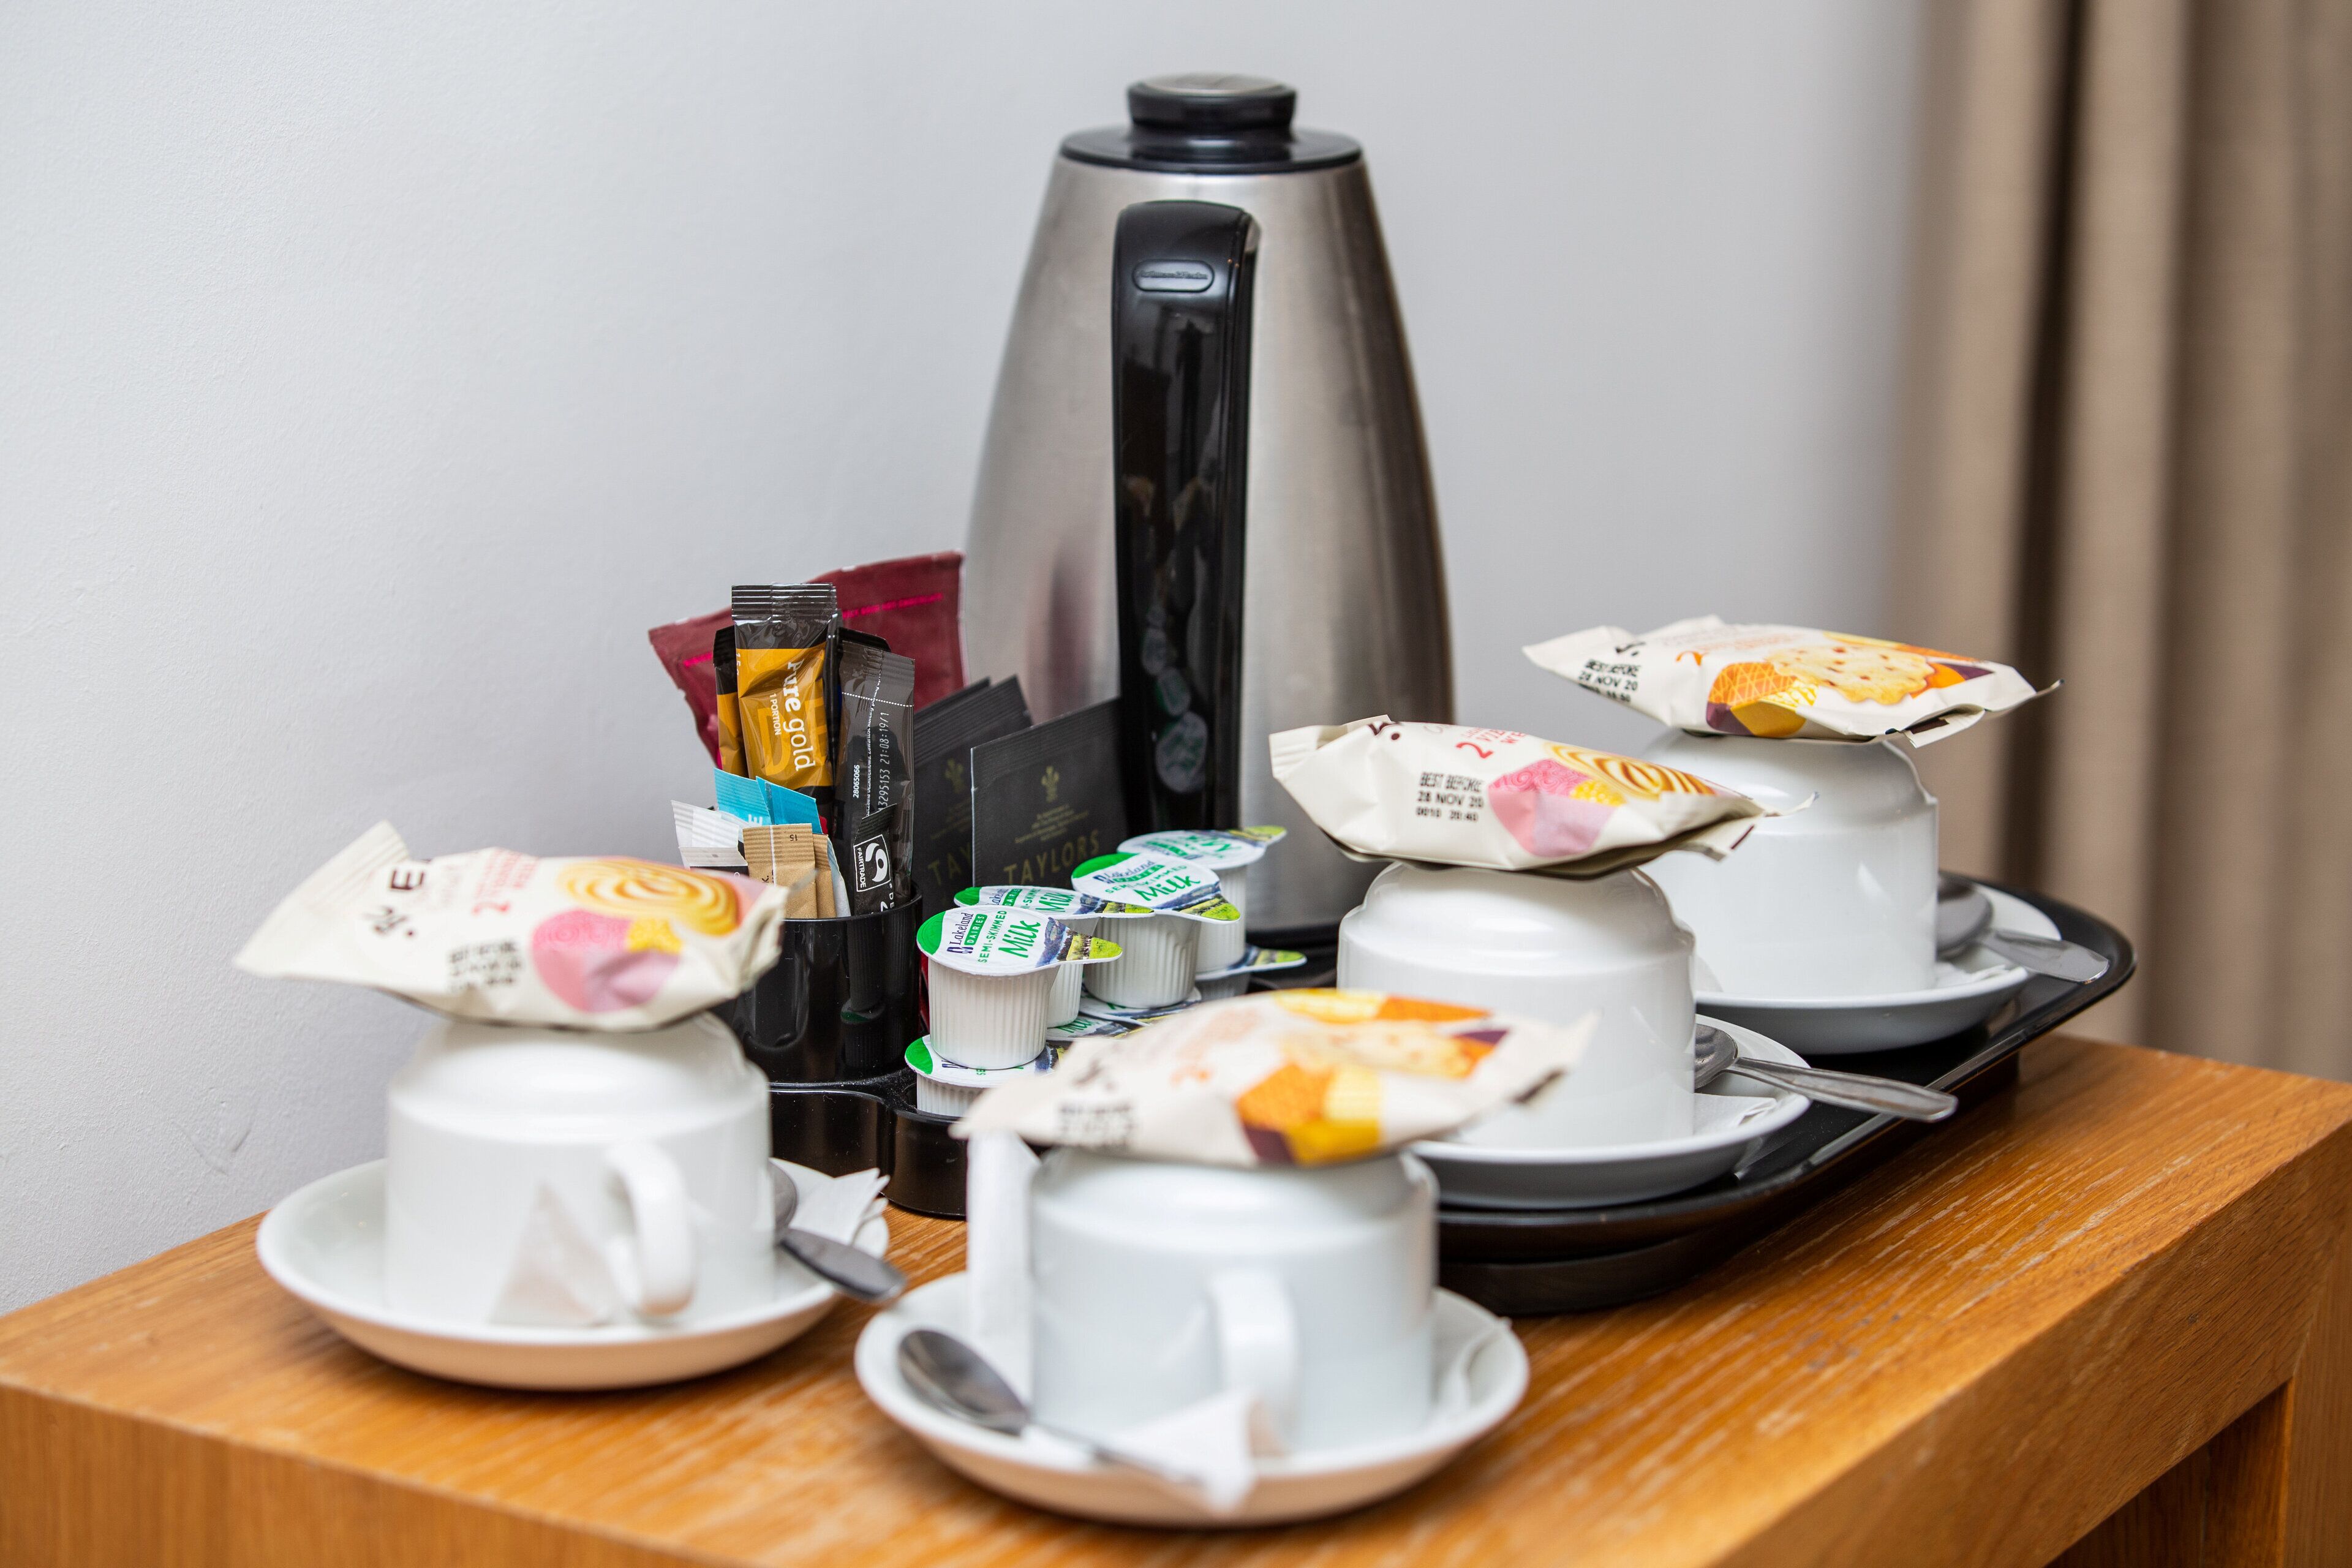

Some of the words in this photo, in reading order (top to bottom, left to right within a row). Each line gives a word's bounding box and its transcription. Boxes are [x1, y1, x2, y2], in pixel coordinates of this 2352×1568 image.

[783, 658, 805, 712] Pure
[771, 699, 782, 736] PORTION
[783, 718, 816, 772] gold
[1420, 771, 1444, 787] BEST
[1446, 774, 1484, 793] BEFORE
[1435, 793, 1465, 806] NOV
[858, 847, 867, 888] FAIRTRADE
[1004, 829, 1101, 885] TAYLORS
[1035, 892, 1076, 913] Milk
[1133, 875, 1201, 902] Milk
[954, 912, 974, 946] Lakeland
[967, 915, 986, 944] DAIRIES
[978, 910, 1008, 963] SEMI-SKIMMED
[998, 920, 1041, 959] Milk
[1095, 941, 1104, 952] UHT
